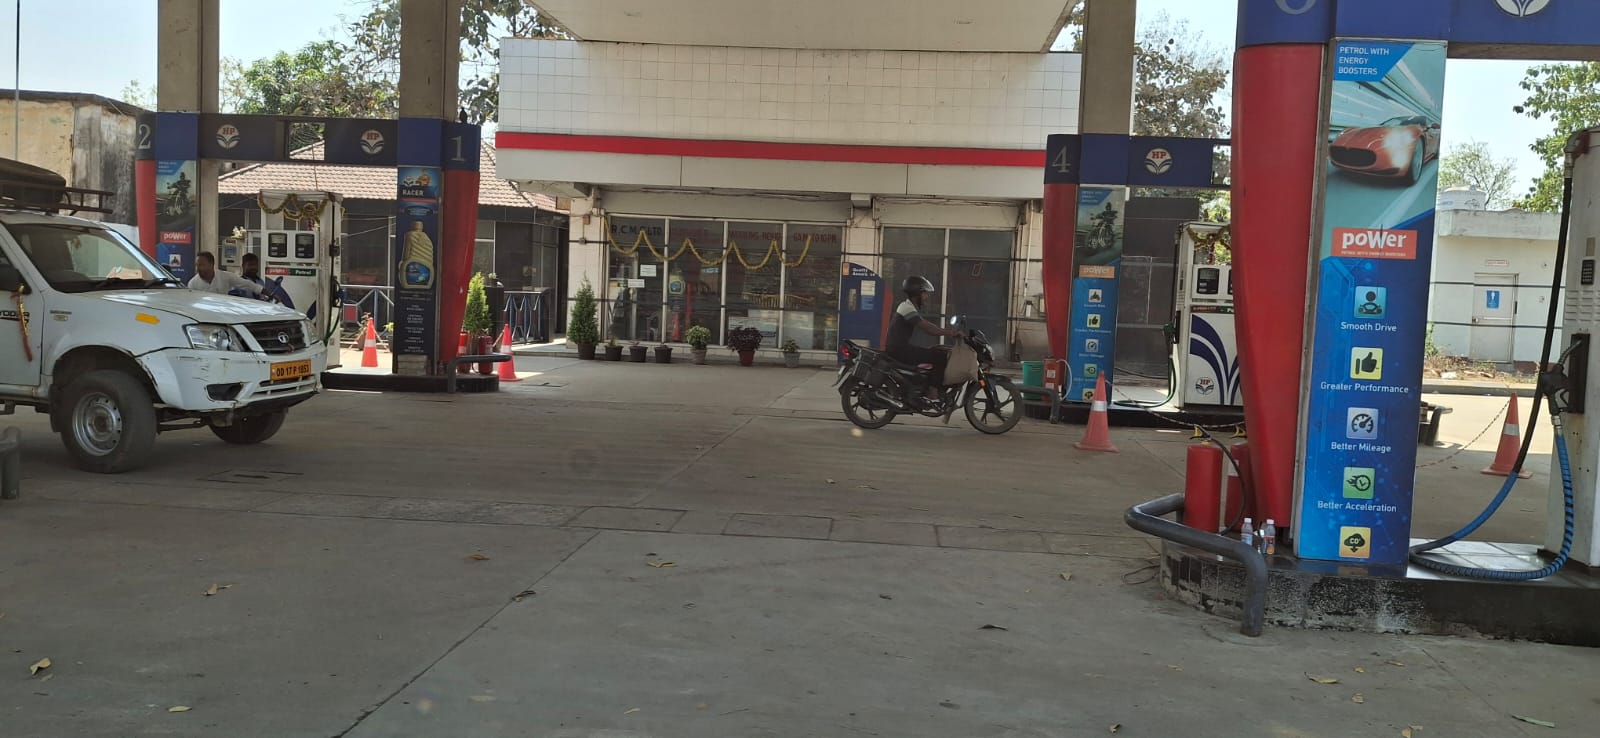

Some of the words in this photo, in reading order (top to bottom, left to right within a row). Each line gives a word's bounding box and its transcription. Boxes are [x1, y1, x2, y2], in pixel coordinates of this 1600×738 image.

[1339, 46, 1369, 55] PETROL
[1370, 47, 1390, 56] WITH
[1339, 56, 1369, 65] ENERGY
[1338, 66, 1378, 75] BOOSTERS
[222, 127, 235, 135] HP
[366, 132, 380, 140] HP
[138, 123, 151, 150] 2
[448, 135, 465, 162] 1
[1051, 144, 1072, 173] 4
[1151, 151, 1167, 159] HP
[402, 188, 425, 197] RACER
[1340, 321, 1373, 331] Smooth
[1375, 322, 1397, 332] Drive
[286, 366, 292, 376] 17
[1320, 381, 1353, 391] Greater
[1354, 382, 1409, 393] Performance
[1330, 441, 1357, 451] Better
[1358, 442, 1392, 454] Mileage
[1317, 500, 1343, 509] Better
[1345, 502, 1397, 513] Acceleration
